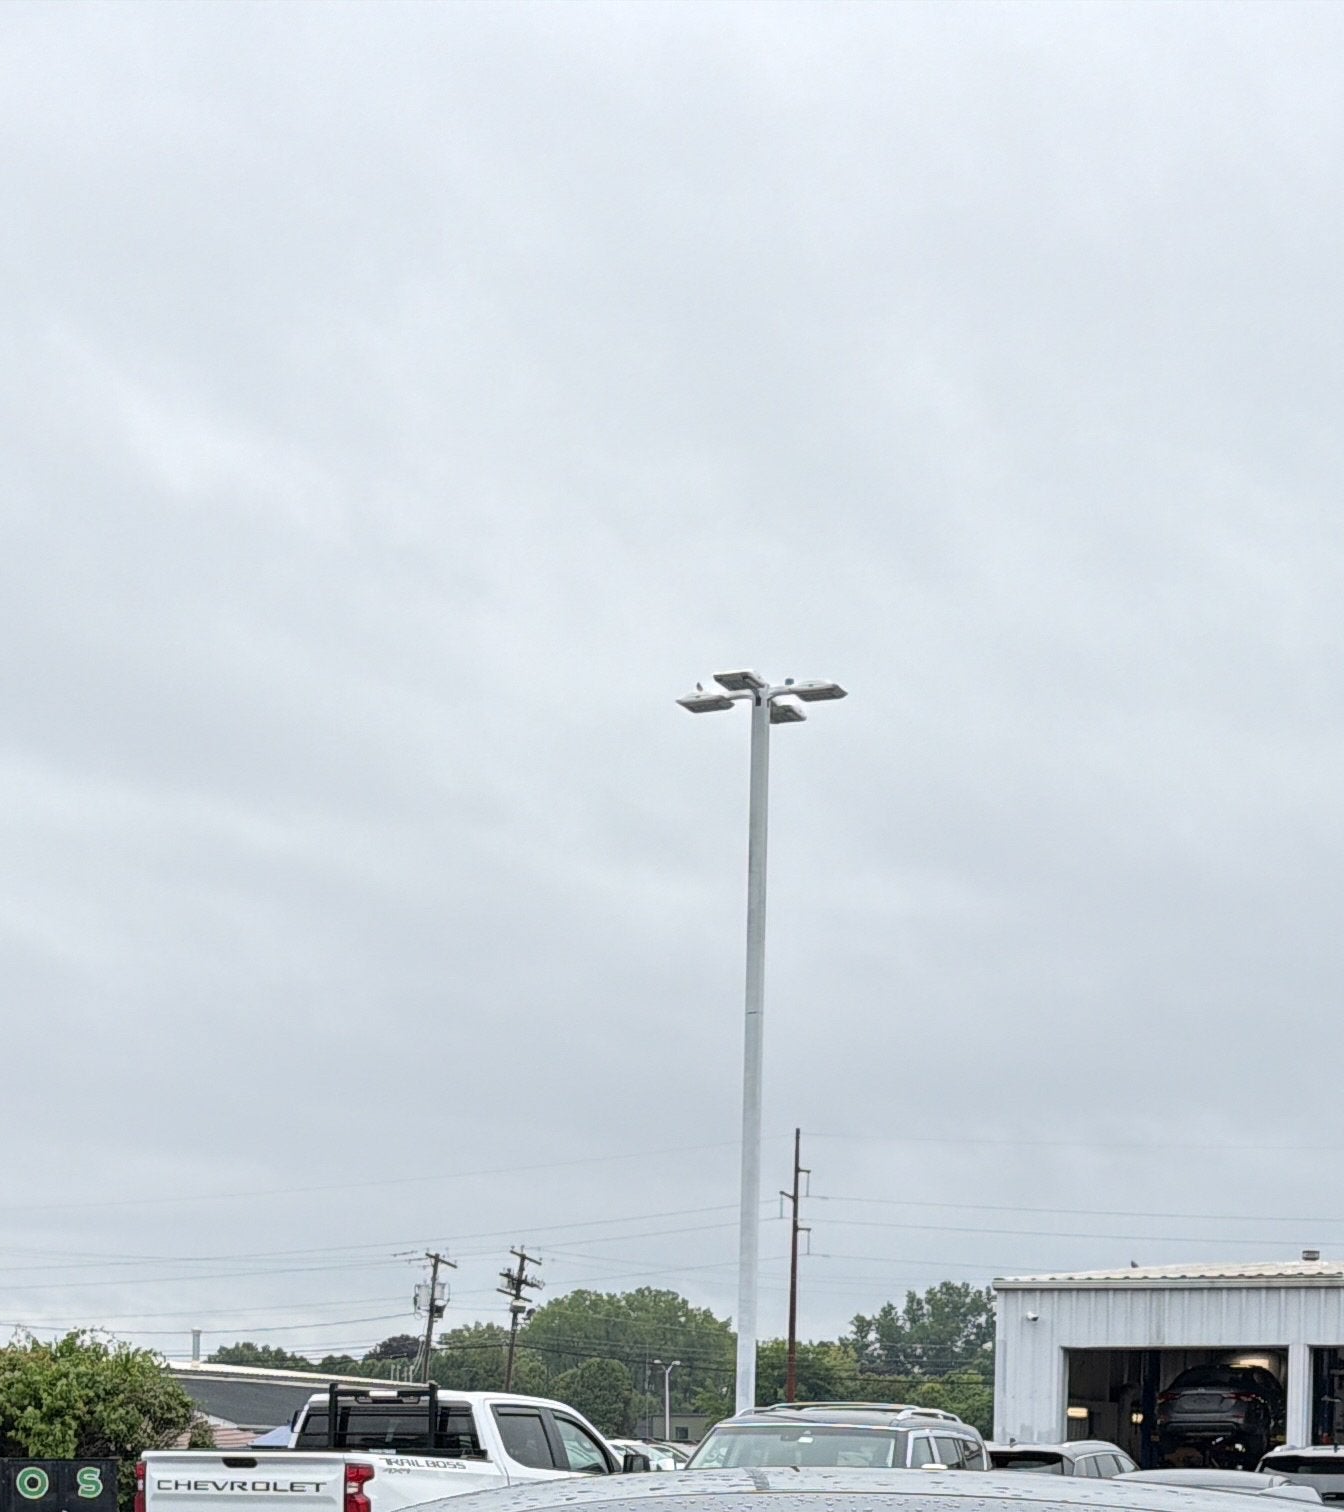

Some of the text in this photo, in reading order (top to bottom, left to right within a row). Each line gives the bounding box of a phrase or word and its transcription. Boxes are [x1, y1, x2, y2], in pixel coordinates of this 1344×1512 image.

[379, 1457, 466, 1470] TRAIL BOSS
[157, 1479, 327, 1493] CHEVROLET
